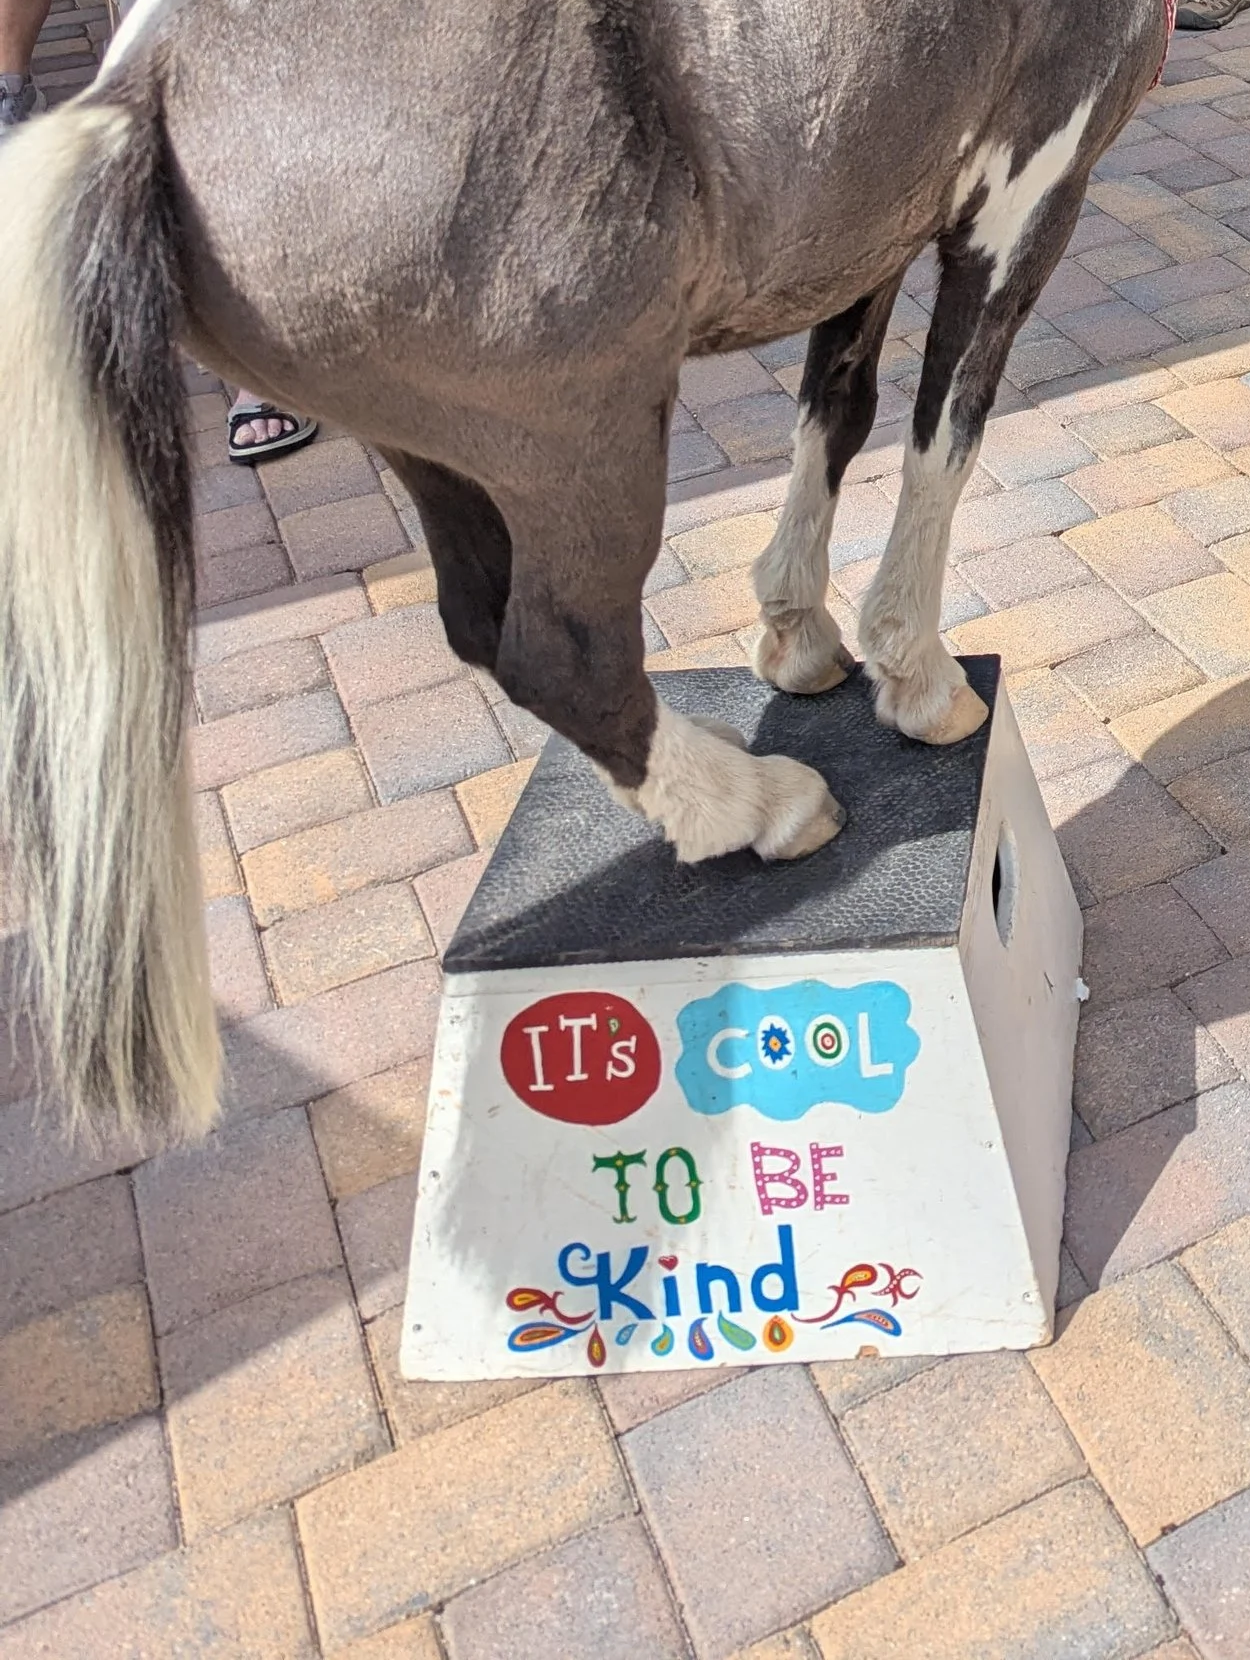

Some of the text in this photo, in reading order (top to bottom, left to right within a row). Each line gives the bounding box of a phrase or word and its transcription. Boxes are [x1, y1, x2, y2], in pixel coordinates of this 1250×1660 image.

[522, 1012, 893, 1091] IT's COOL
[591, 1142, 849, 1224] TO BE
[558, 1224, 798, 1321] Kind
